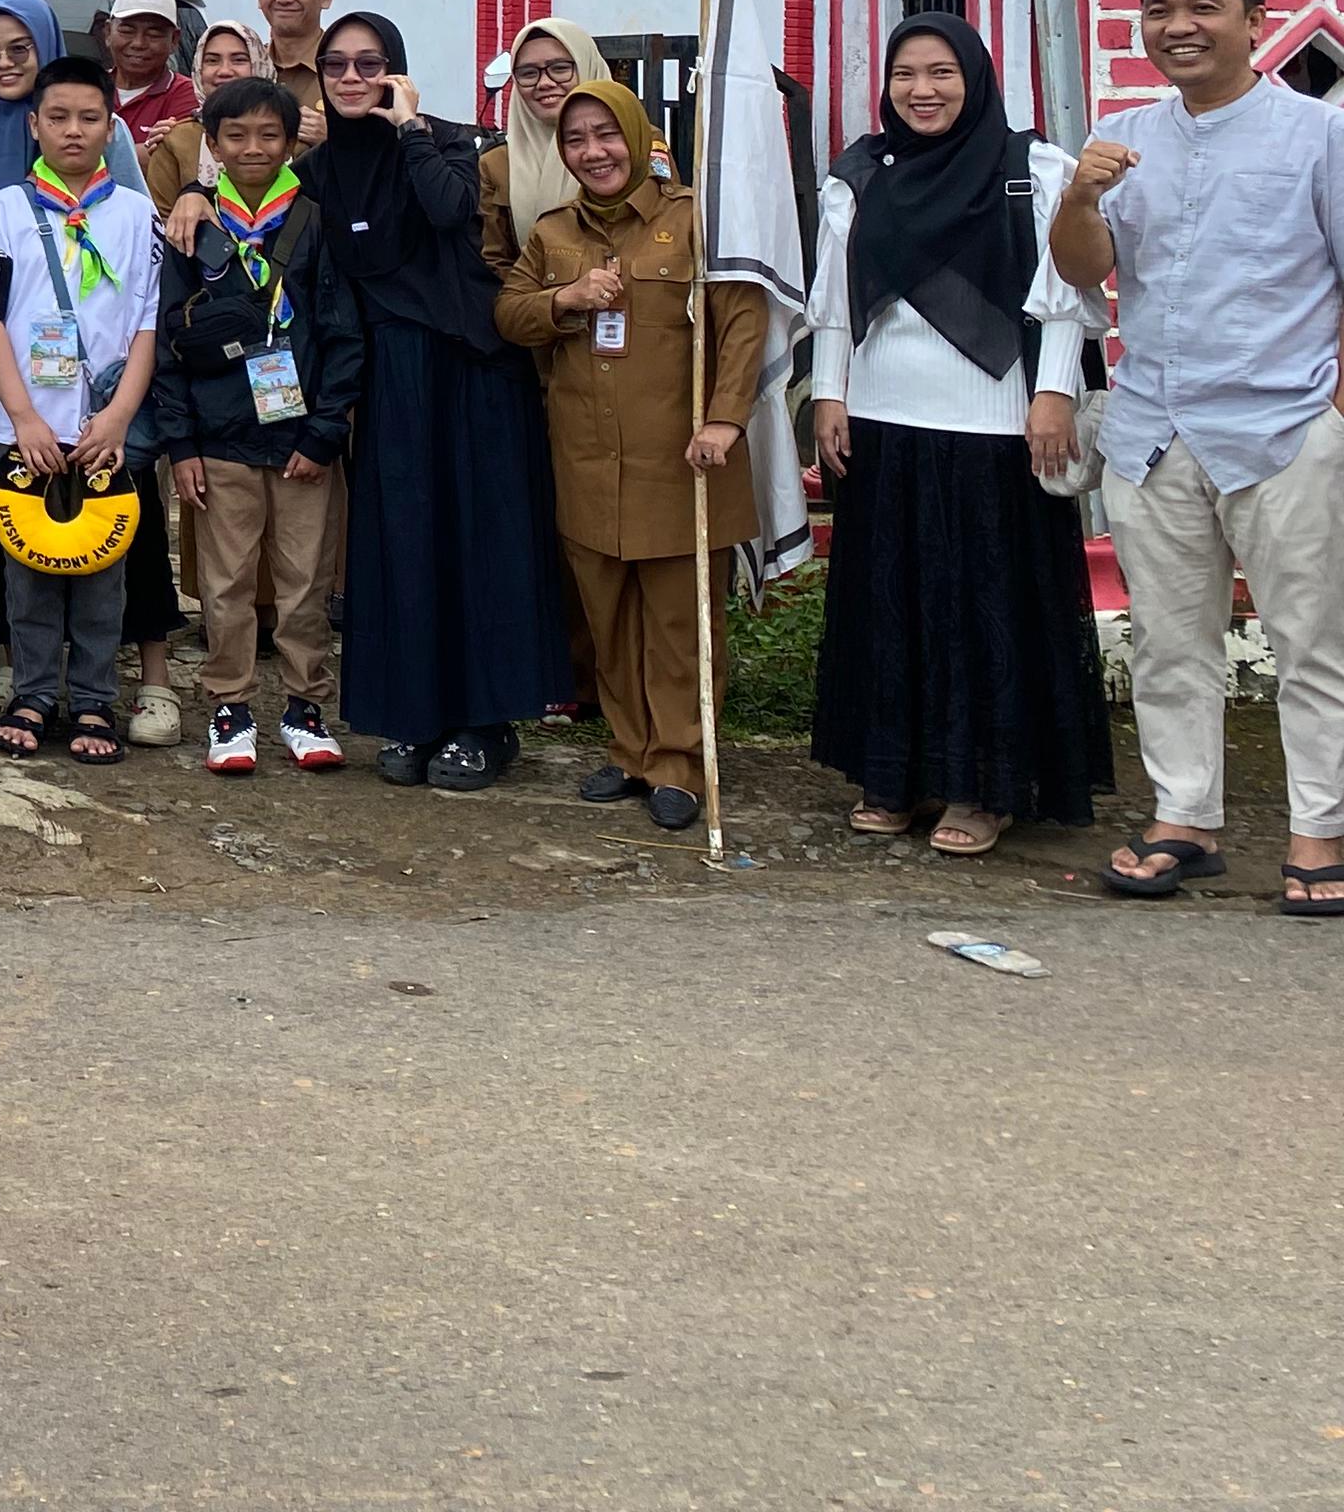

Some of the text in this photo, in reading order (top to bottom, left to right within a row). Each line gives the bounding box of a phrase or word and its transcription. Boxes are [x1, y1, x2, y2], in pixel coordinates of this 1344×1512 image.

[0, 504, 129, 569] HOLIDAY ANGKASA WISATA
